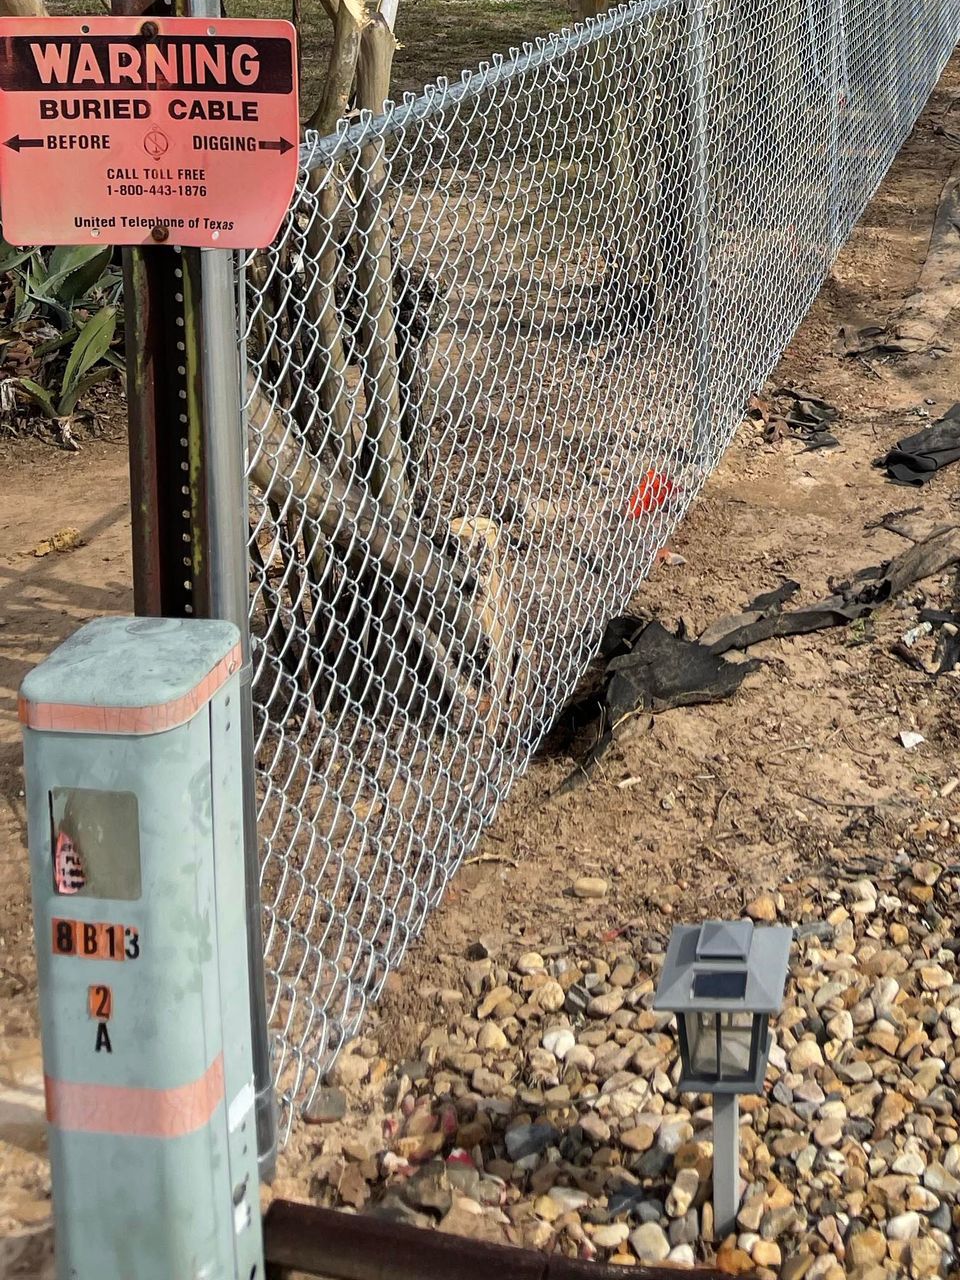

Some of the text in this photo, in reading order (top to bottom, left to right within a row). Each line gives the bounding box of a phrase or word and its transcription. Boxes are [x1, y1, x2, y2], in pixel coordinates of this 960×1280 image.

[30, 43, 260, 86] WARNING
[40, 99, 258, 121] BURIED CABLE
[47, 135, 257, 152] BEFORE DIGGING
[107, 168, 206, 181] CALL TOLL FREE
[107, 184, 207, 197] 1-800-443-1876
[74, 216, 234, 230] United Telephone of Texas
[95, 985, 110, 1019] 2
[95, 1022, 112, 1053] A
